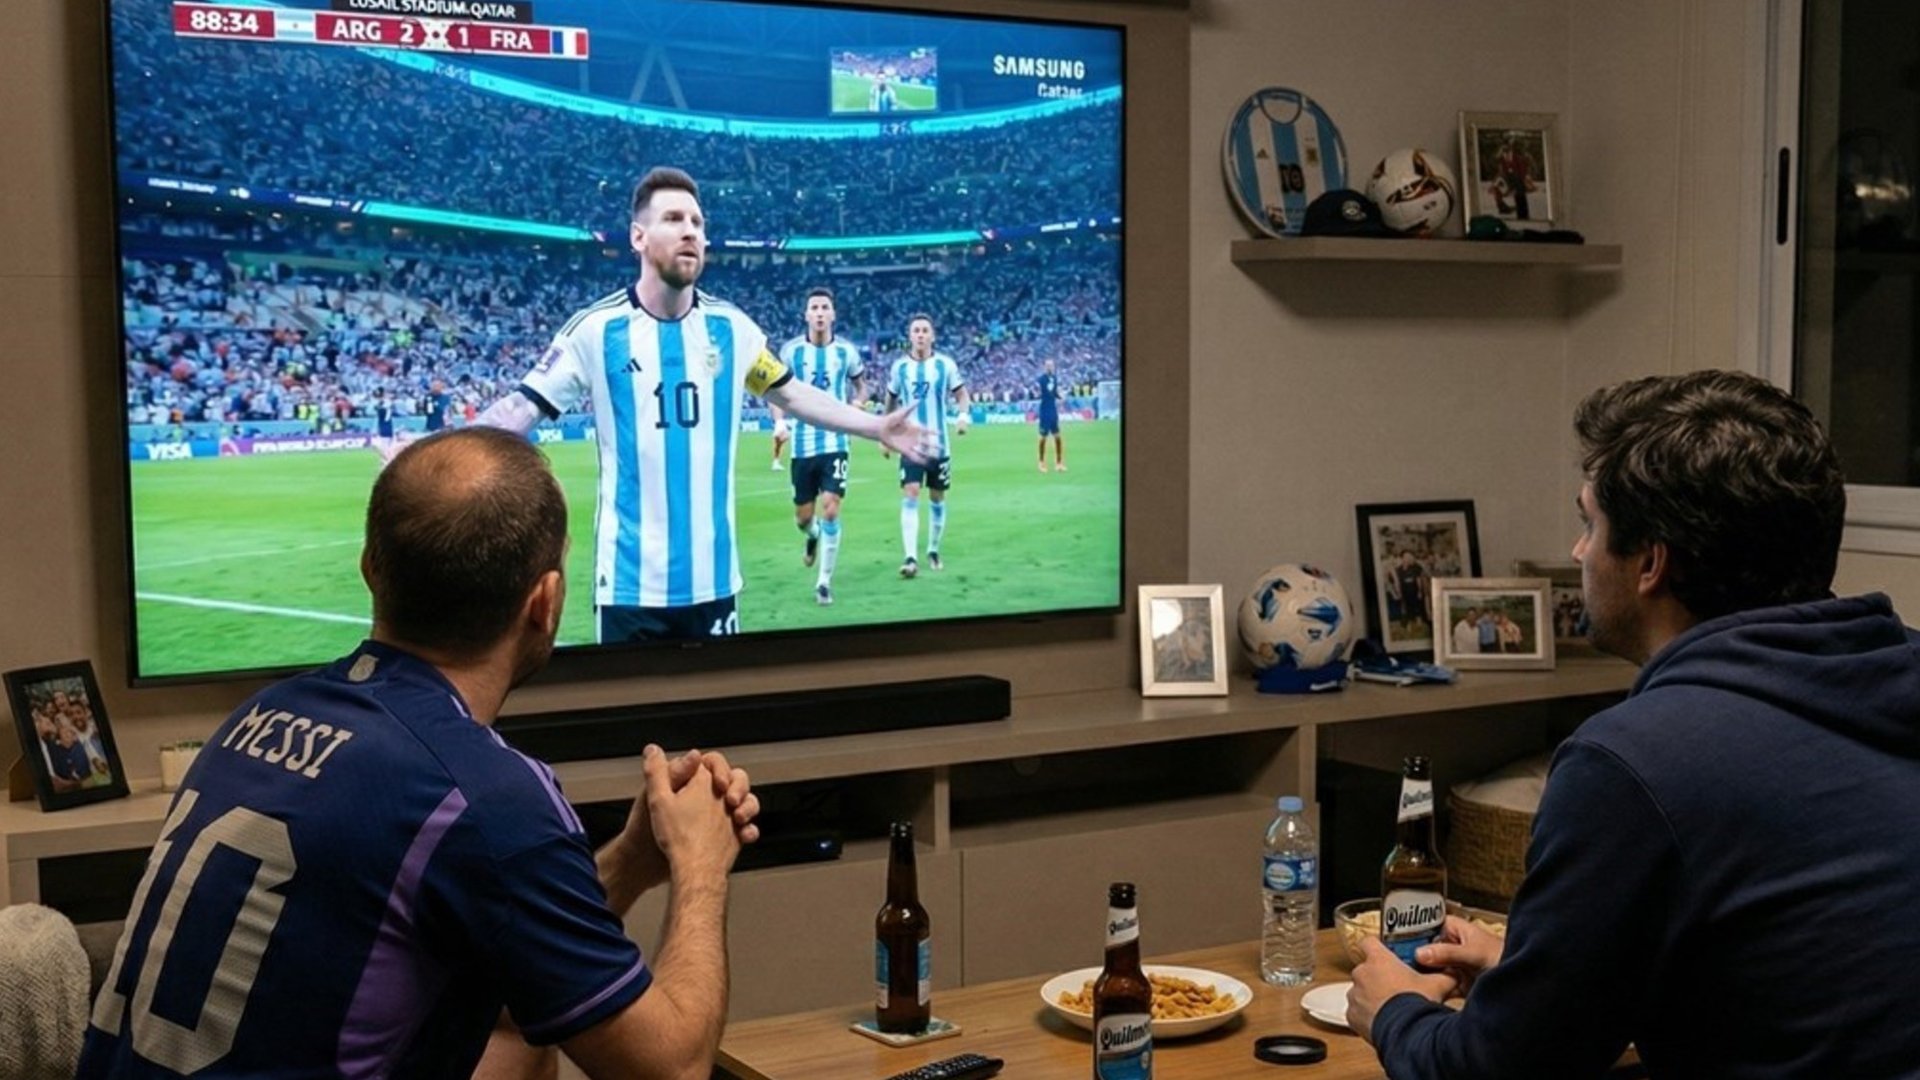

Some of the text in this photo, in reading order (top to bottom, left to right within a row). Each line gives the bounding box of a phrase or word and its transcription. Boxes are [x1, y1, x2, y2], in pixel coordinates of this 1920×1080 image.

[190, 9, 259, 34] 88:34
[471, 3, 516, 19] QATAR
[333, 18, 534, 50] ARG 2 1 FRA
[993, 54, 1085, 80] SAMSUNG
[653, 381, 699, 430] 10
[147, 442, 193, 460] VISA
[221, 703, 353, 779] MESSI
[91, 788, 297, 1076] 10
